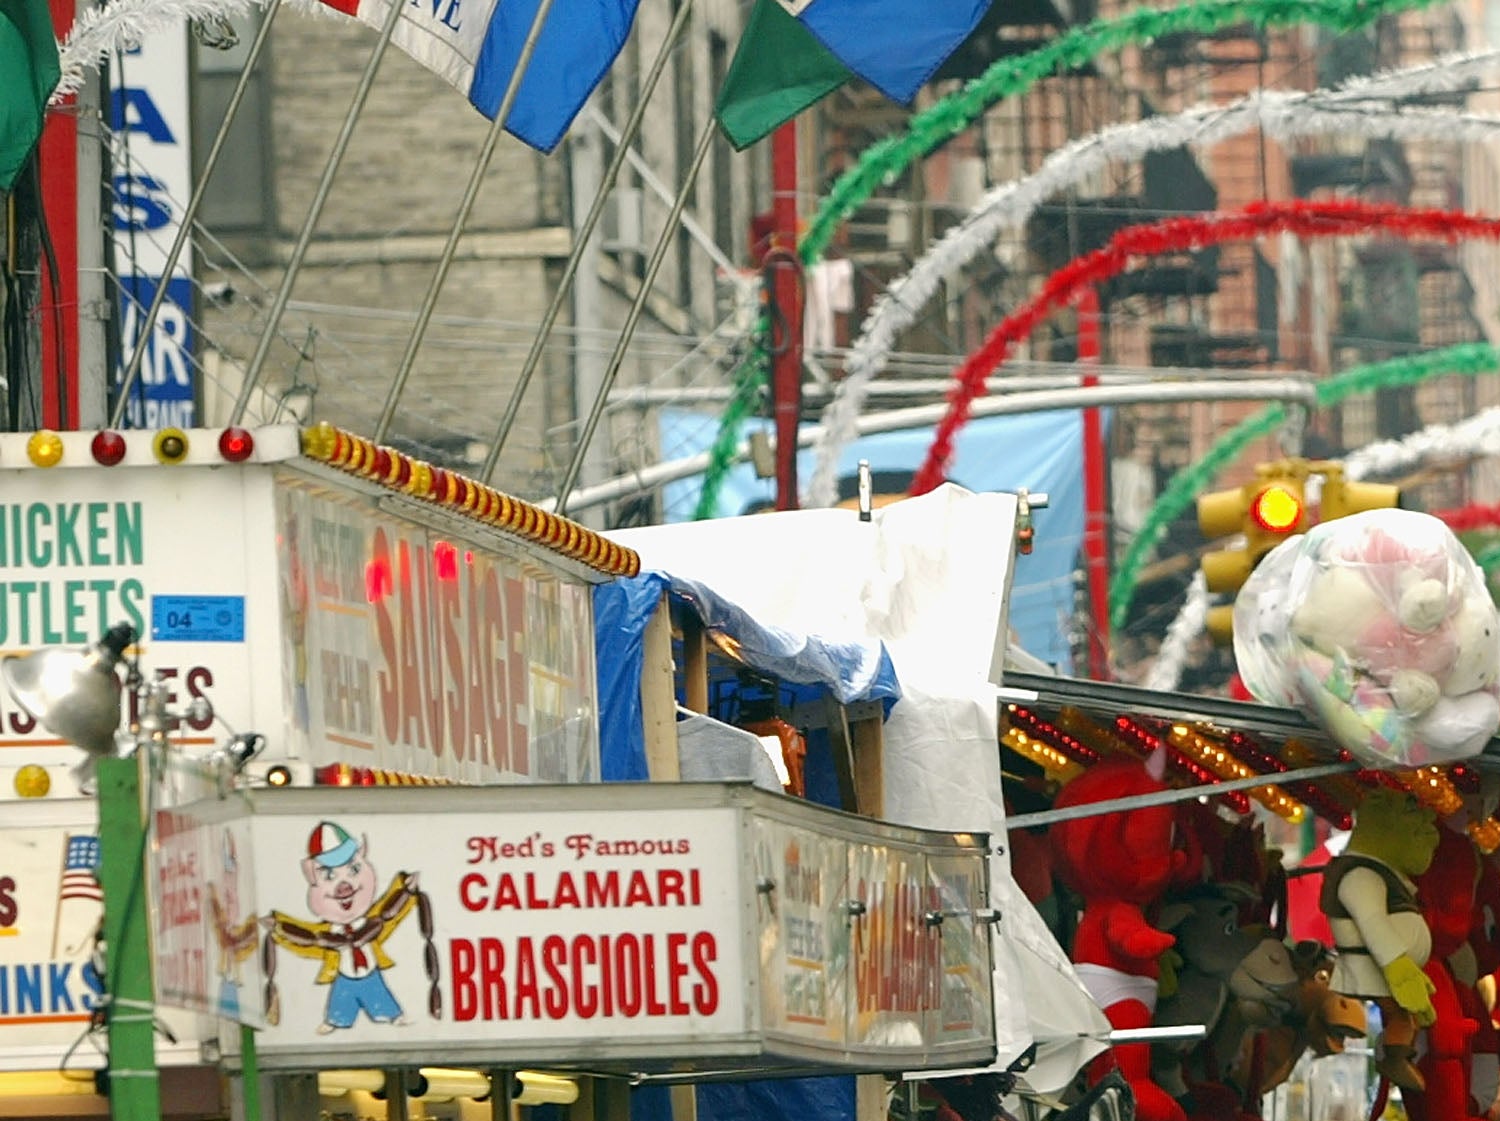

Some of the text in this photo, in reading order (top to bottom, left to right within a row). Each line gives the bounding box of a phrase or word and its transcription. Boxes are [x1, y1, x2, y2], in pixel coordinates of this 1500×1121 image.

[368, 526, 528, 776] SAUSAGE
[466, 832, 690, 864] Ned's Famous
[459, 868, 701, 912] CALAMARI
[450, 931, 719, 1022] BRASCIOLES
